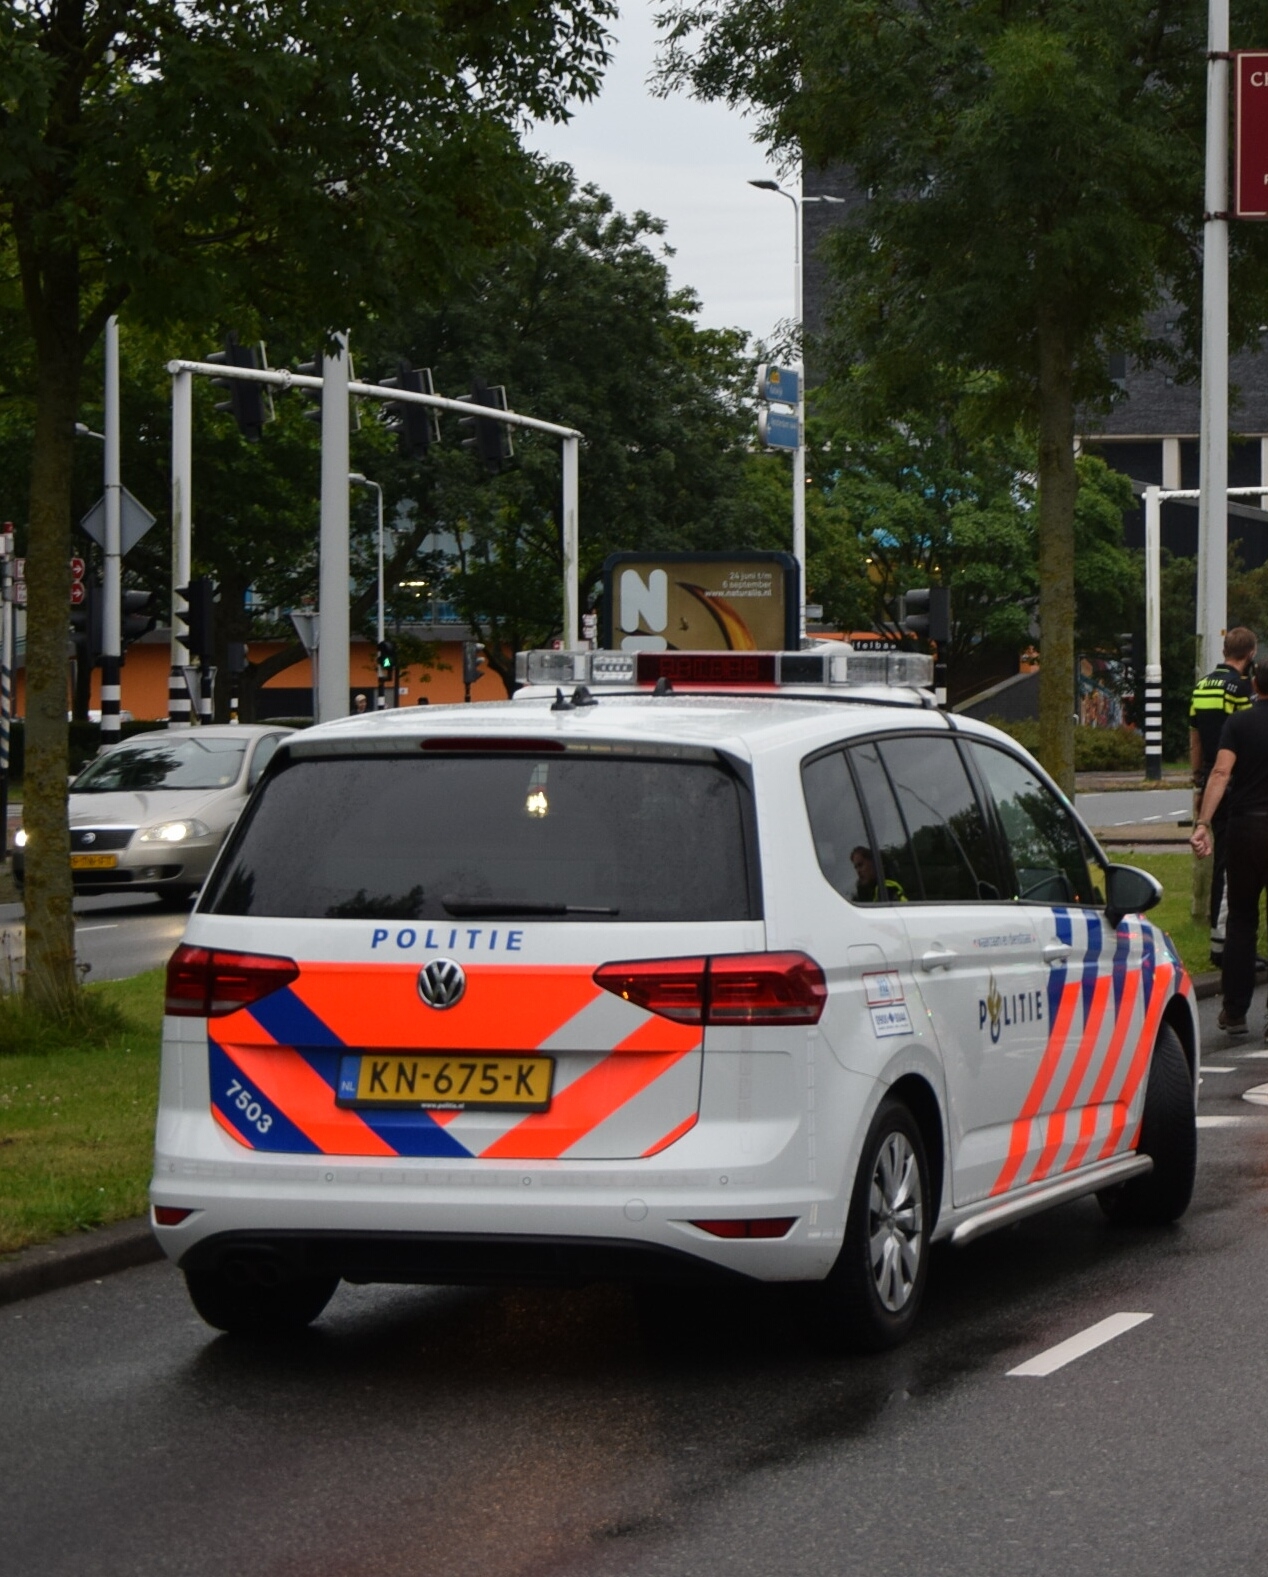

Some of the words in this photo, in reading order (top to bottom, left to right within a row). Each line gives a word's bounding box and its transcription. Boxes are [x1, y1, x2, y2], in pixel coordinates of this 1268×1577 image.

[729, 581, 772, 590] september
[741, 572, 756, 582] juni
[620, 568, 668, 633] N
[371, 929, 524, 950] POLITIE
[341, 1081, 355, 1092] NL
[369, 1061, 535, 1096] KN-675-K
[226, 1078, 273, 1134] 7503
